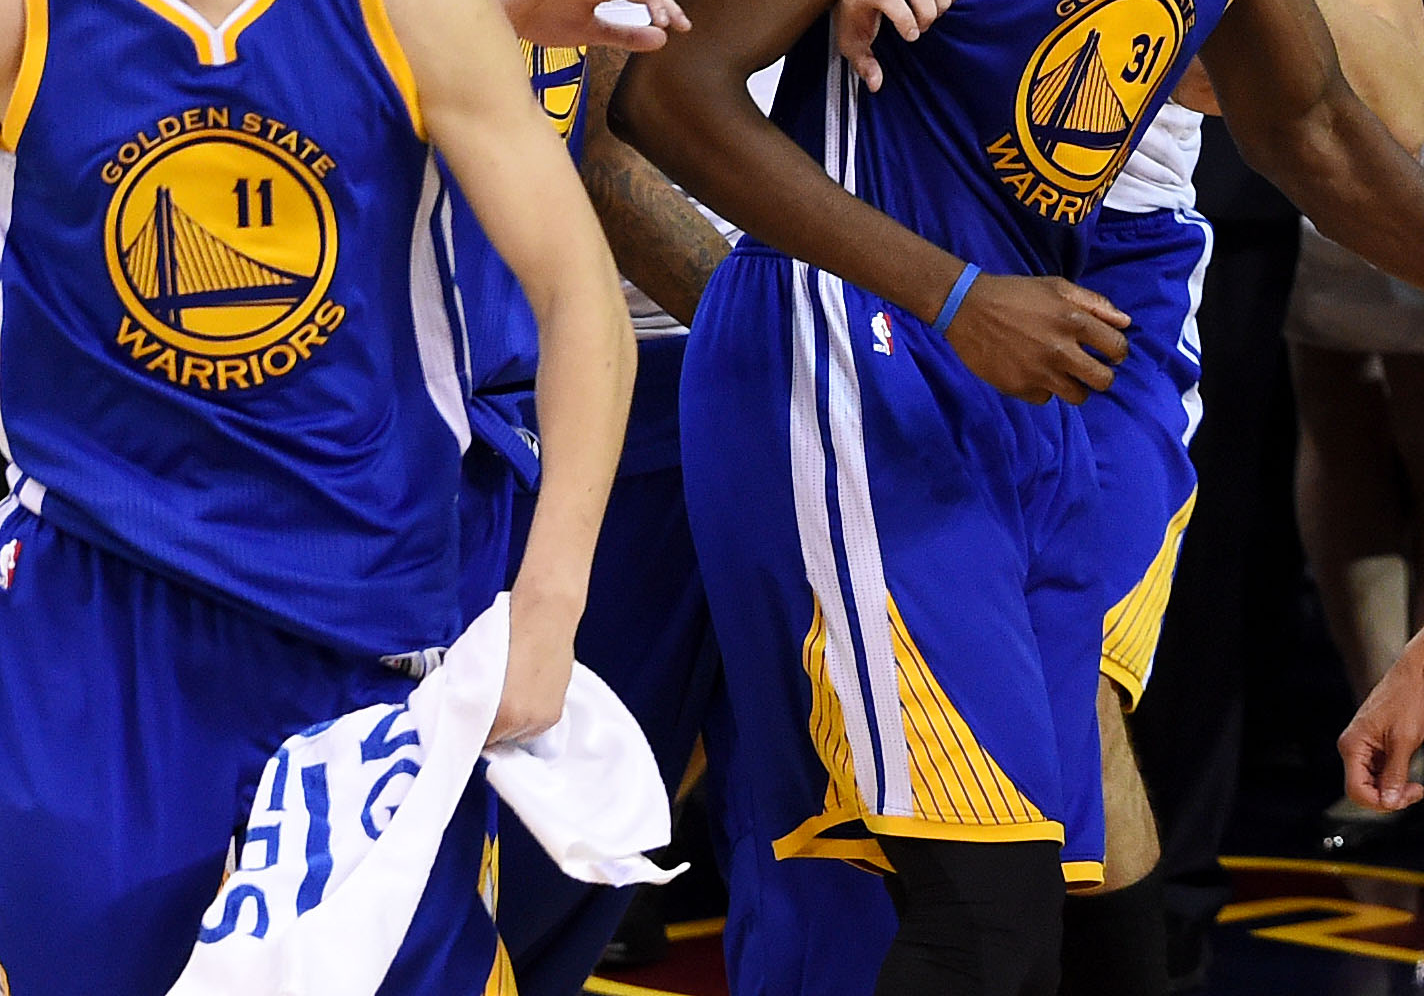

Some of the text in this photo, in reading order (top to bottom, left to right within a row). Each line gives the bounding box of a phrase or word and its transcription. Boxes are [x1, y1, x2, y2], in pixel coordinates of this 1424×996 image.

[1120, 33, 1166, 85] 31
[101, 107, 337, 185] GOLDEN STATE
[232, 178, 274, 228] 11
[116, 300, 346, 391] WARRIORS
